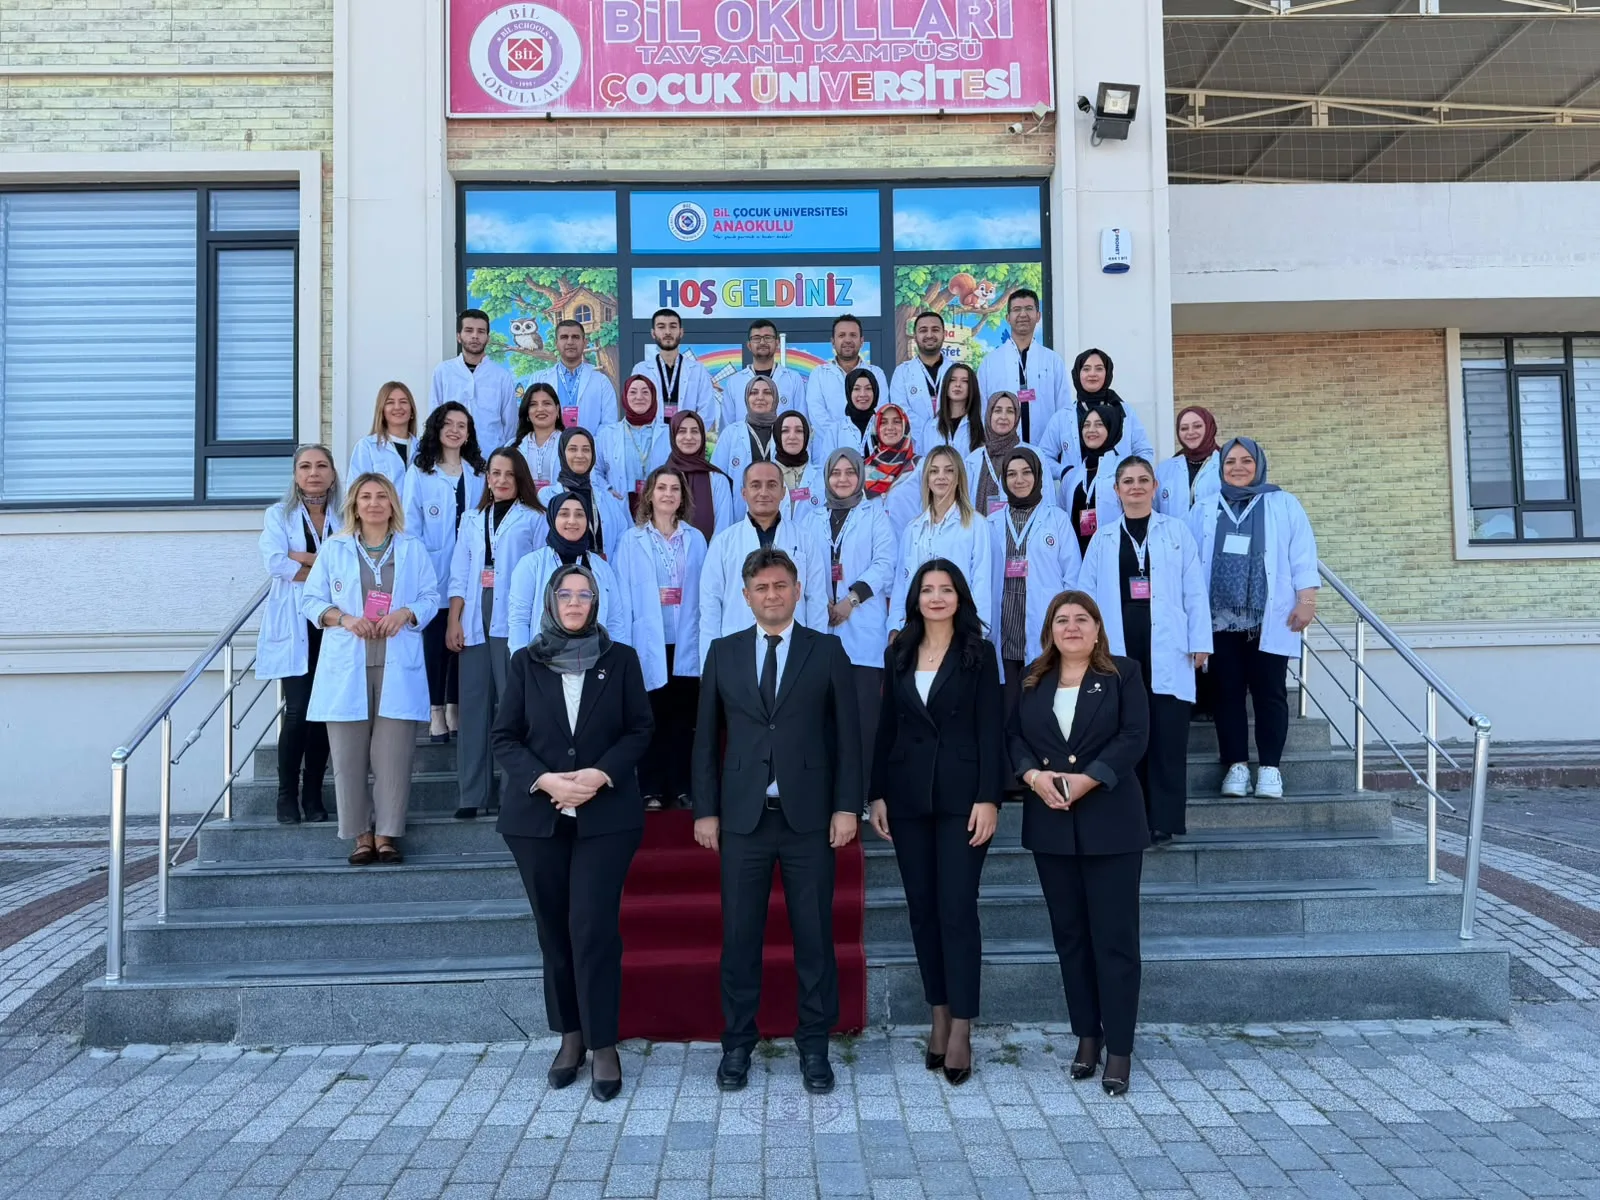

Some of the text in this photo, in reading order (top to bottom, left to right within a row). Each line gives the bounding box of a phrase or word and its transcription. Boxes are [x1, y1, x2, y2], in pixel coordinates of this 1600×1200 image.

[509, 4, 540, 20] BİL
[603, 0, 1014, 44] BİL OKULLARI
[513, 22, 550, 38] SCHOOLS
[514, 47, 537, 60] BİL
[636, 39, 983, 67] TAVŞANLI KAMPÜSÜ
[484, 76, 568, 104] OKULLARI
[599, 62, 1022, 109] ÇOCUK ÜNİVERSİTESİ
[733, 207, 771, 219] ÇOCUK
[773, 206, 848, 217] ÜNİVERSİTESİ
[713, 220, 794, 232] ANAOKULU
[659, 272, 854, 315] HOŞ GELDİNİZ
